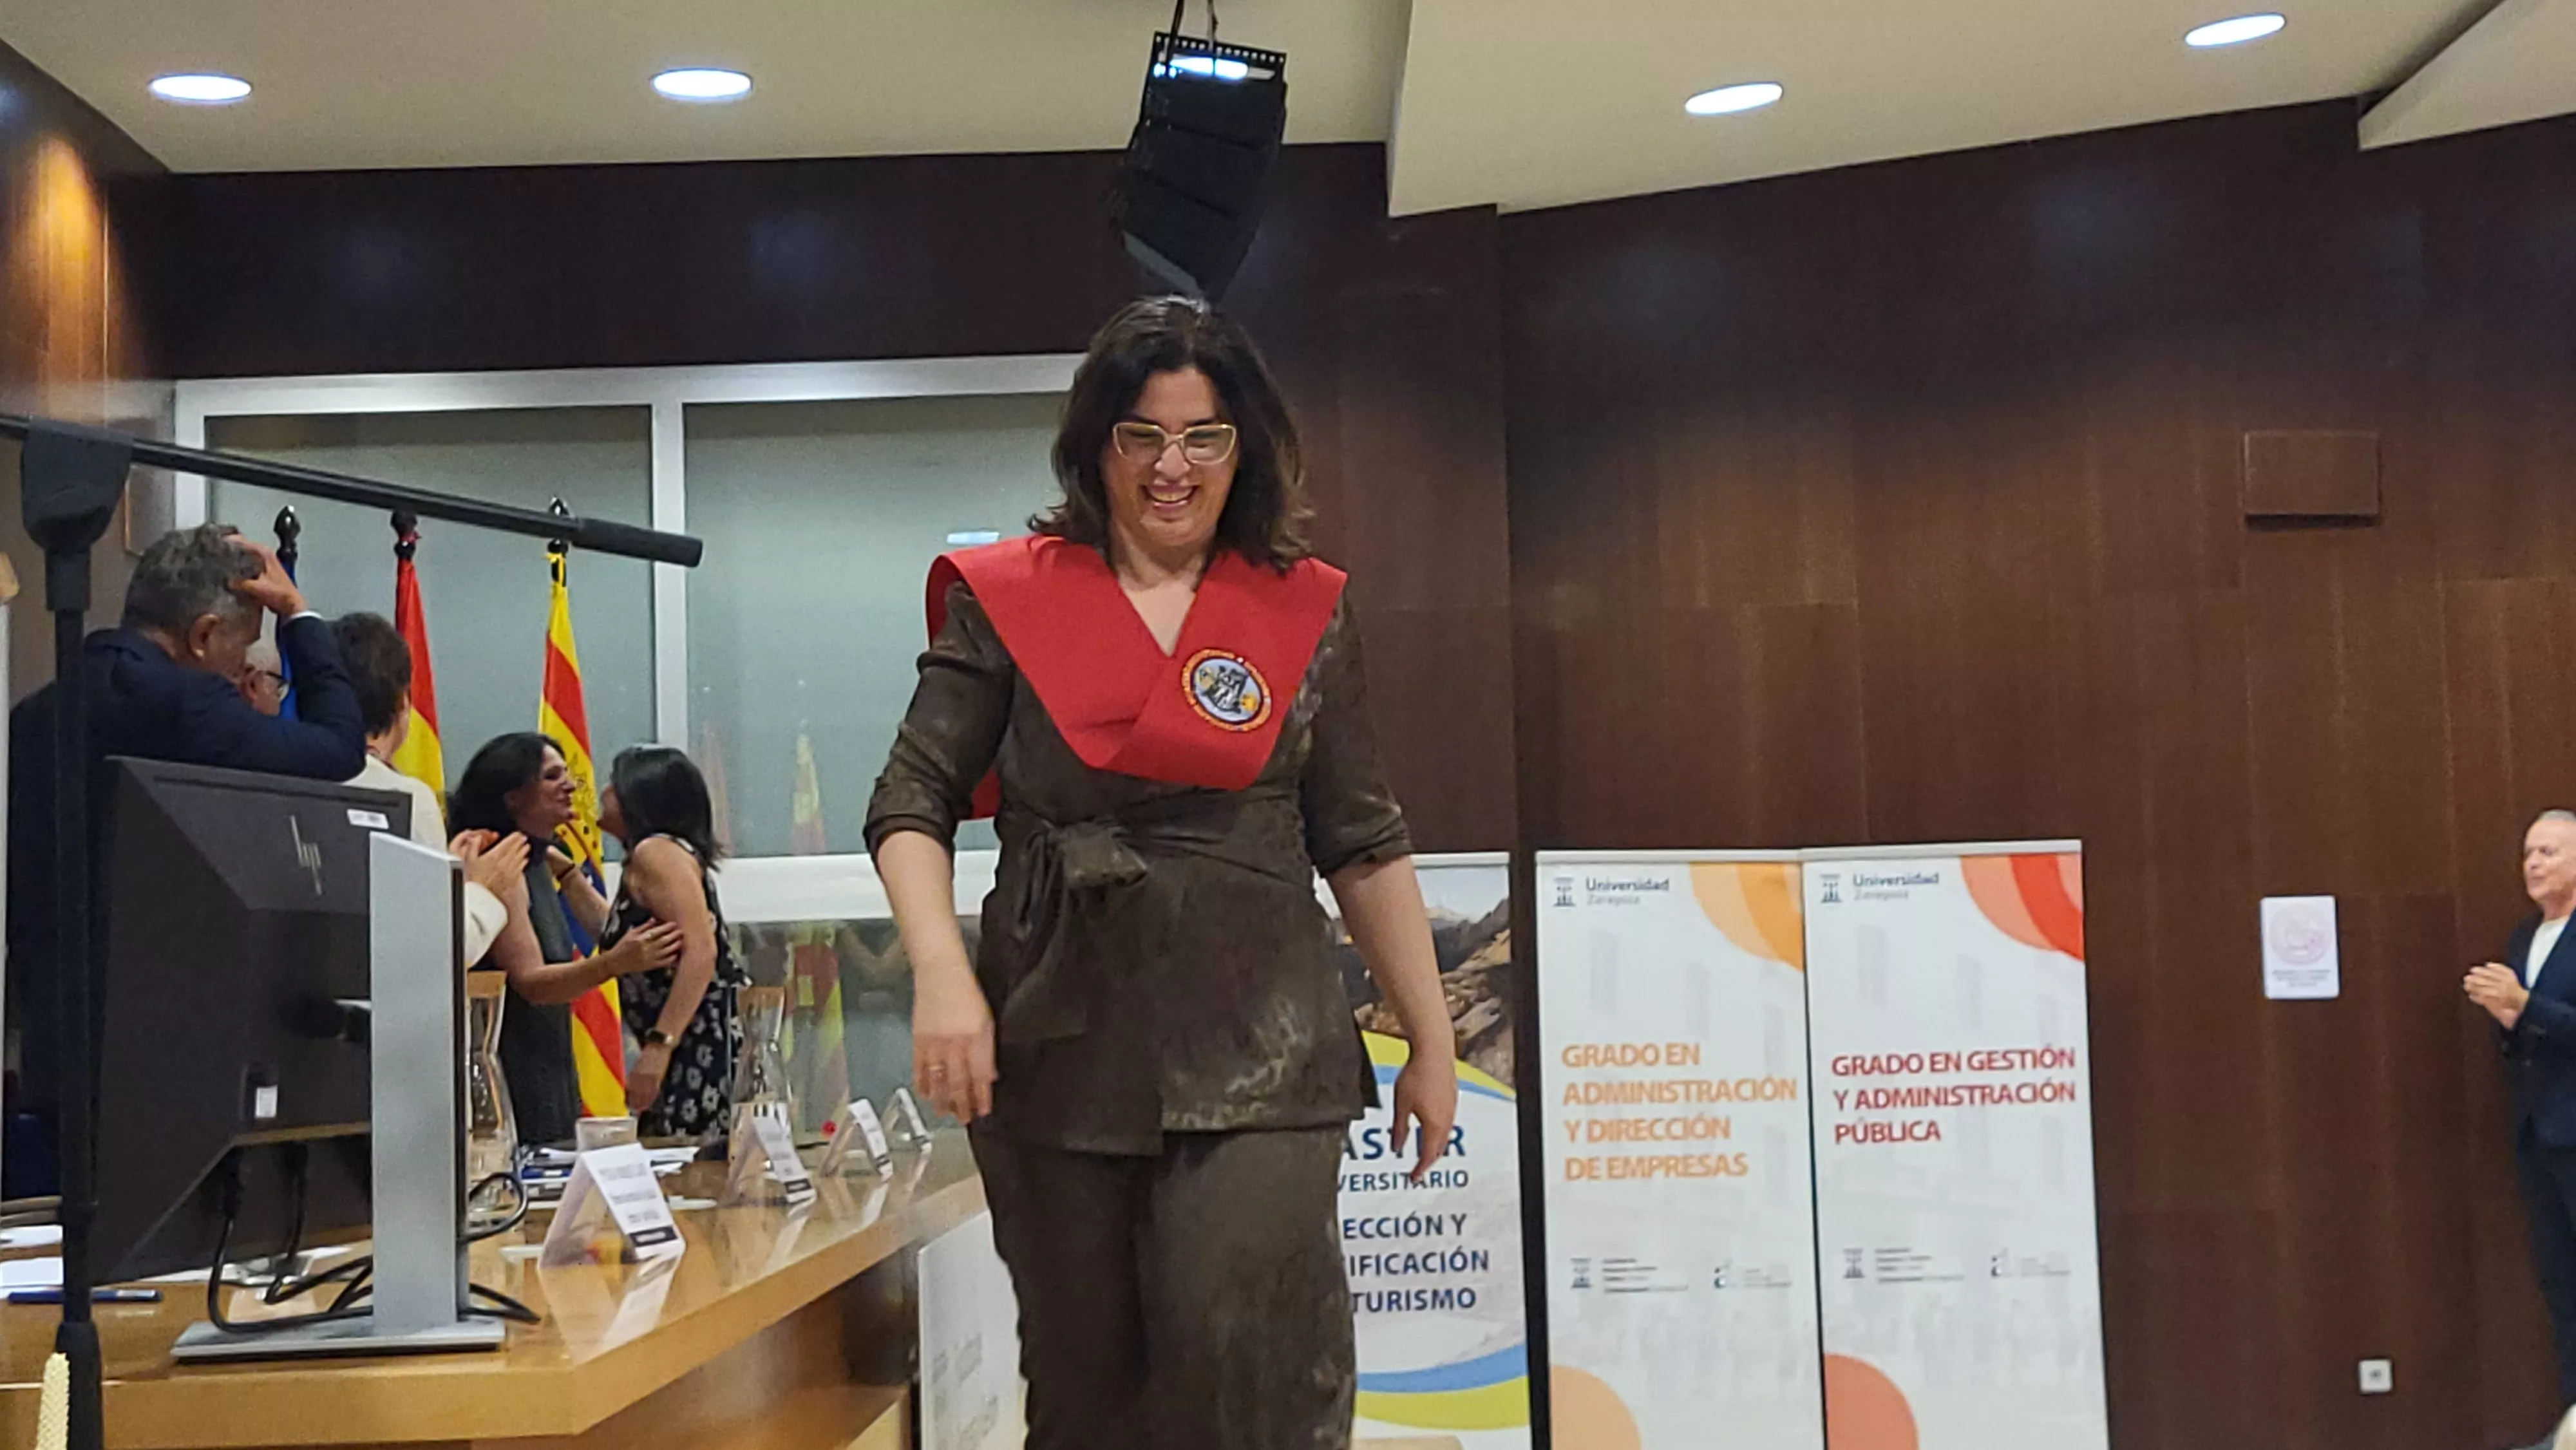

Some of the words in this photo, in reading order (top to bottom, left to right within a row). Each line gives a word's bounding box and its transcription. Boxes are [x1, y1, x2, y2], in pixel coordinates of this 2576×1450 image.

[1562, 1044, 1660, 1068] GRADO
[1665, 1042, 1701, 1066] EN
[1832, 1052, 1924, 1077] GRADO
[1929, 1051, 1961, 1073] EN
[1967, 1044, 2076, 1071] GESTIÓN
[1562, 1074, 1797, 1106] ADMINISTRACIÓN
[1832, 1089, 1849, 1111] Y
[1854, 1077, 2076, 1110] ADMINISTRACIÓN
[1564, 1120, 1581, 1144] Y
[1587, 1112, 1732, 1144] DIRECCIÓN
[1834, 1117, 1942, 1144] PÚBLICA
[1565, 1157, 1602, 1181] DE
[1606, 1152, 1748, 1180] EMPRESAS
[1450, 1213, 1467, 1236] Y
[1352, 1287, 1477, 1313] TURISMO
